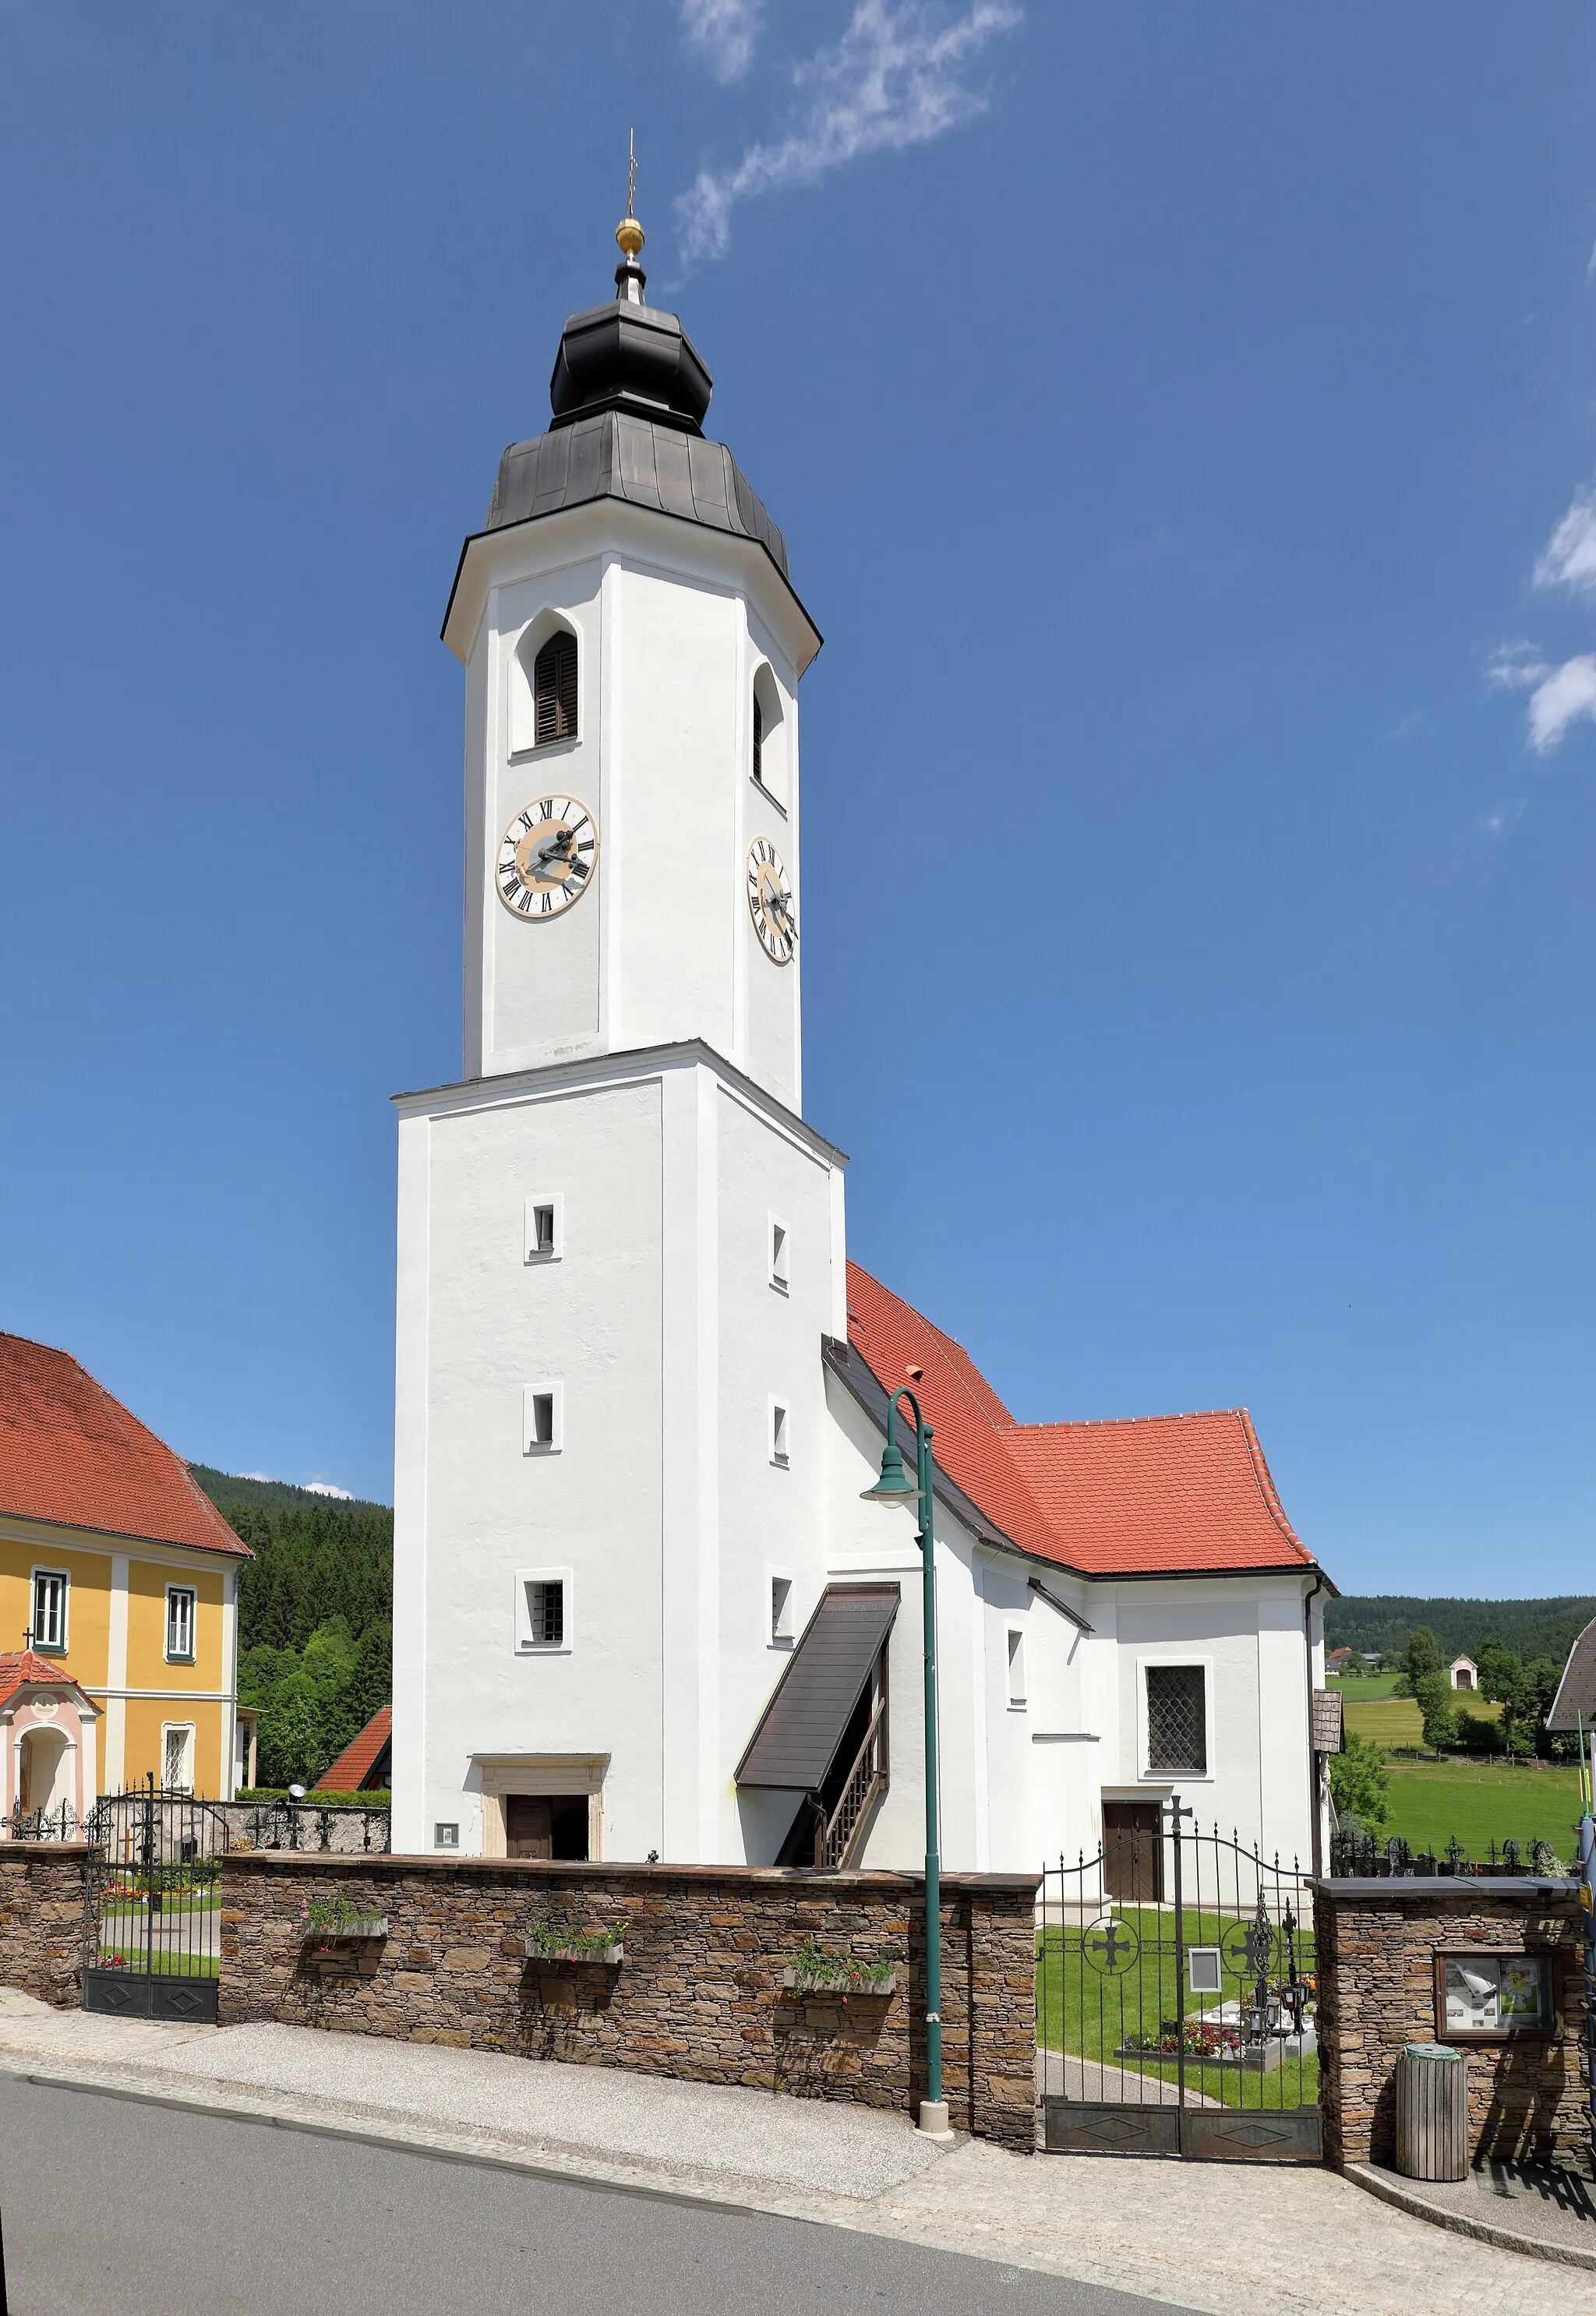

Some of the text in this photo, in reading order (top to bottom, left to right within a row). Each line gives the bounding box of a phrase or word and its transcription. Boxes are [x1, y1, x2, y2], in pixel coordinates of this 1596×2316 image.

[517, 810, 534, 832] XI
[539, 799, 553, 821] XII
[573, 815, 588, 831] II
[578, 838, 594, 853] III
[500, 859, 515, 874] IX
[503, 877, 521, 901] VIII
[517, 890, 533, 912] VII
[541, 891, 552, 913] VI
